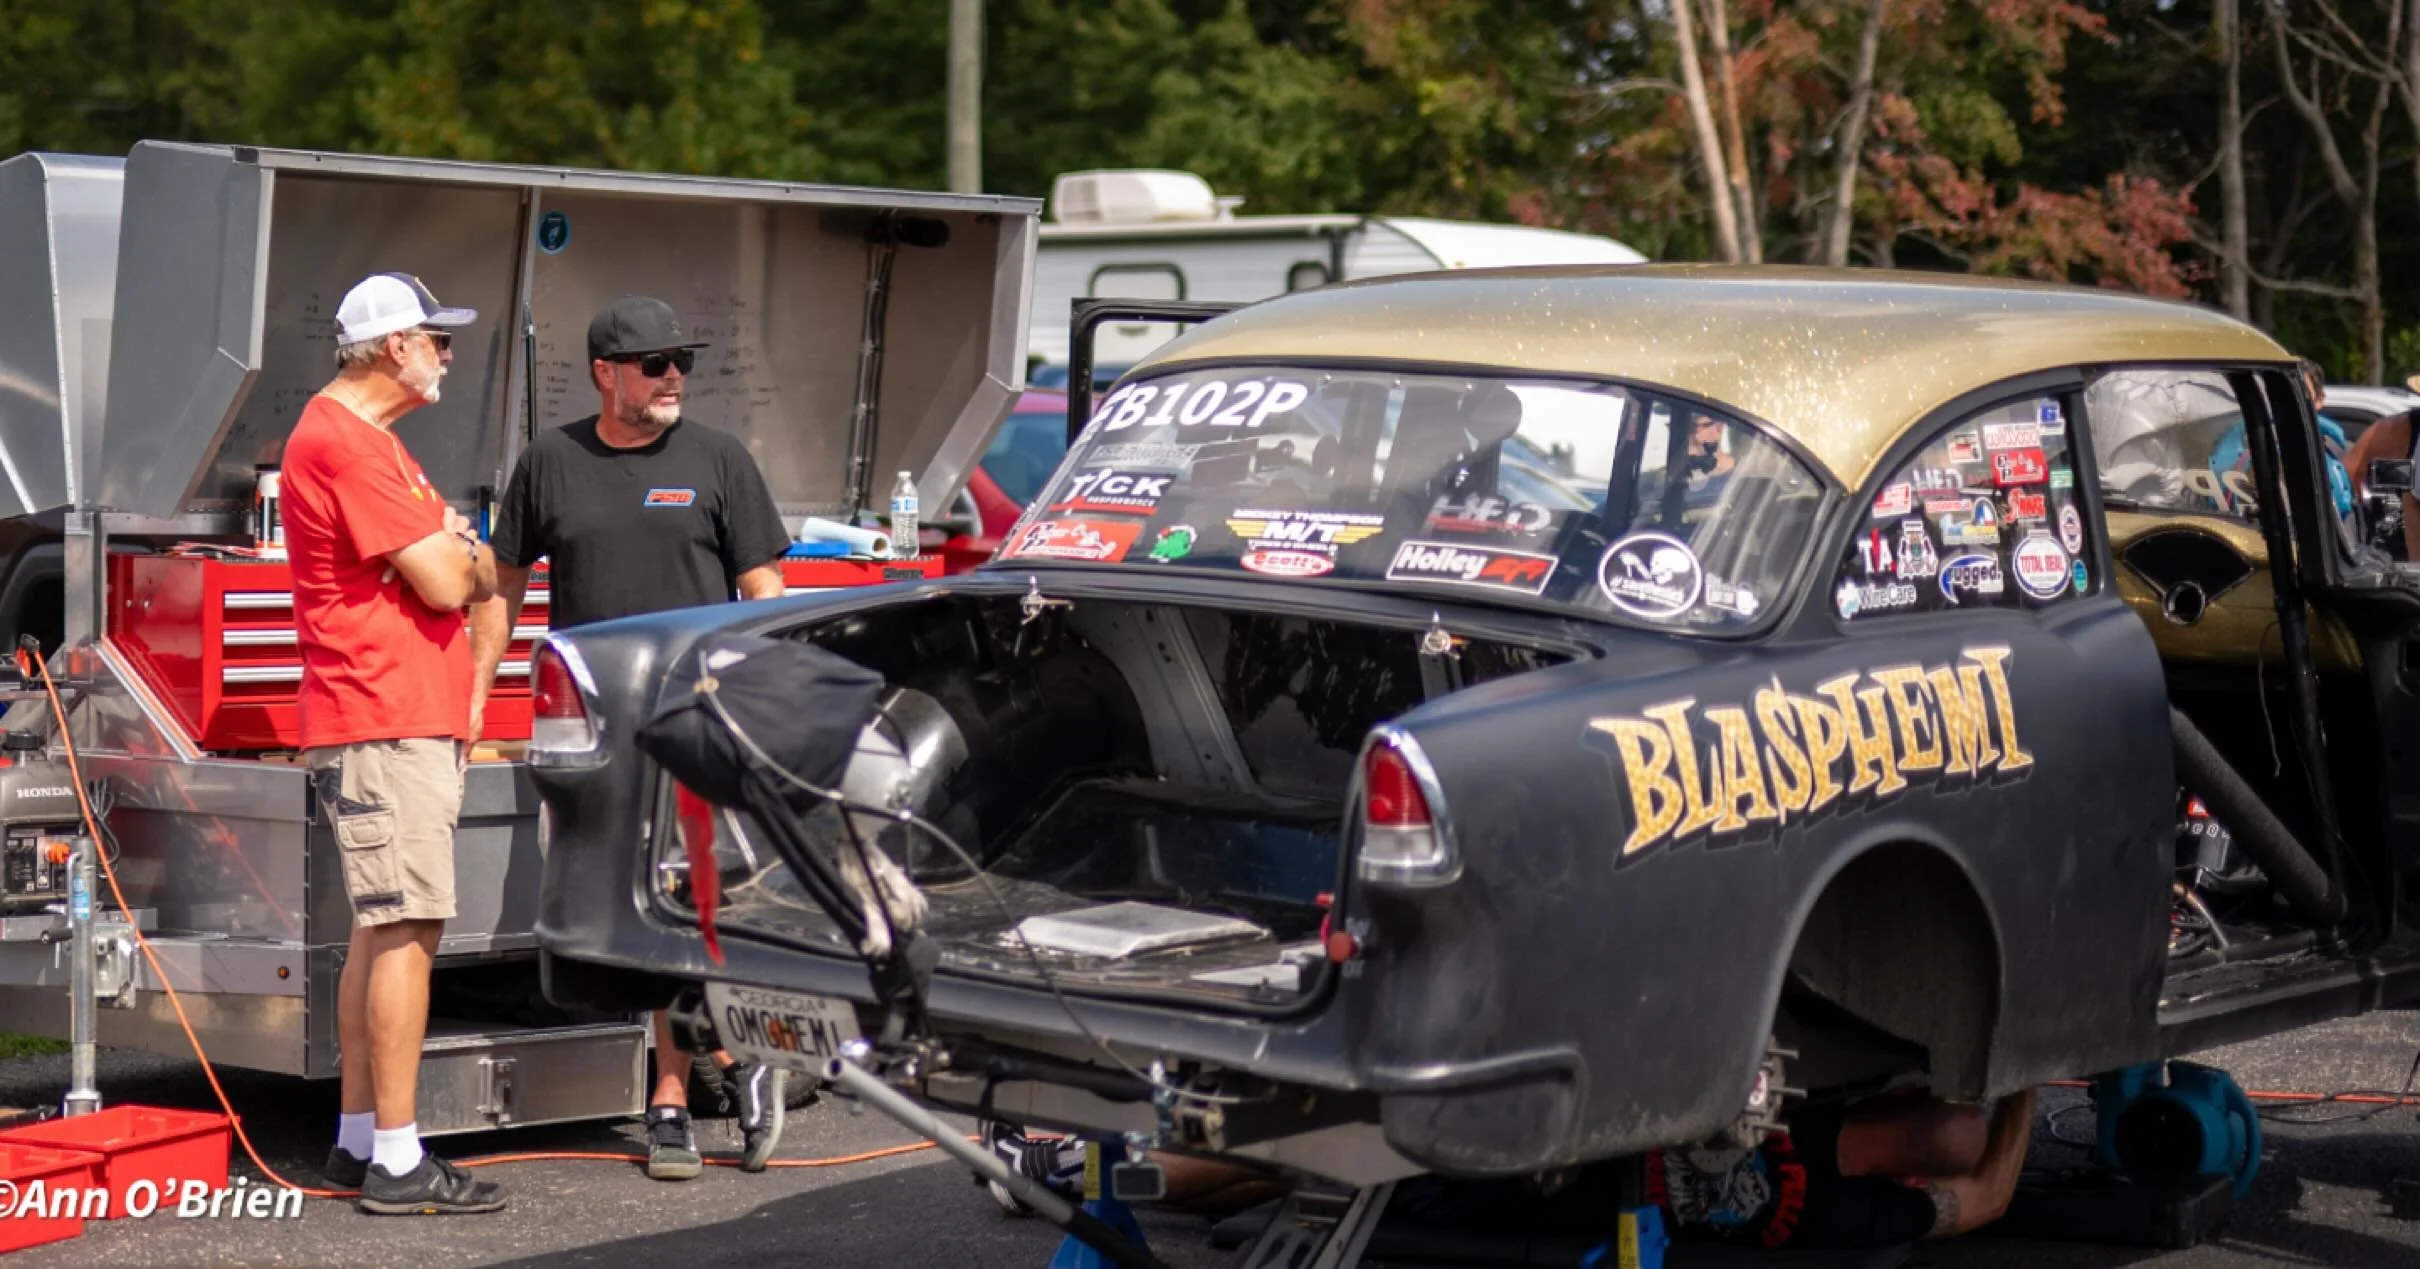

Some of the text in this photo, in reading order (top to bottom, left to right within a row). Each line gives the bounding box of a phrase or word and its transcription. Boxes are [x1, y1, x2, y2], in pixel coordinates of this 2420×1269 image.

[1396, 545, 1487, 581] Holley
[1589, 645, 2035, 855] BLASPHEMI
[16, 786, 74, 798] HONDA
[739, 990, 819, 1014] GEORGIA
